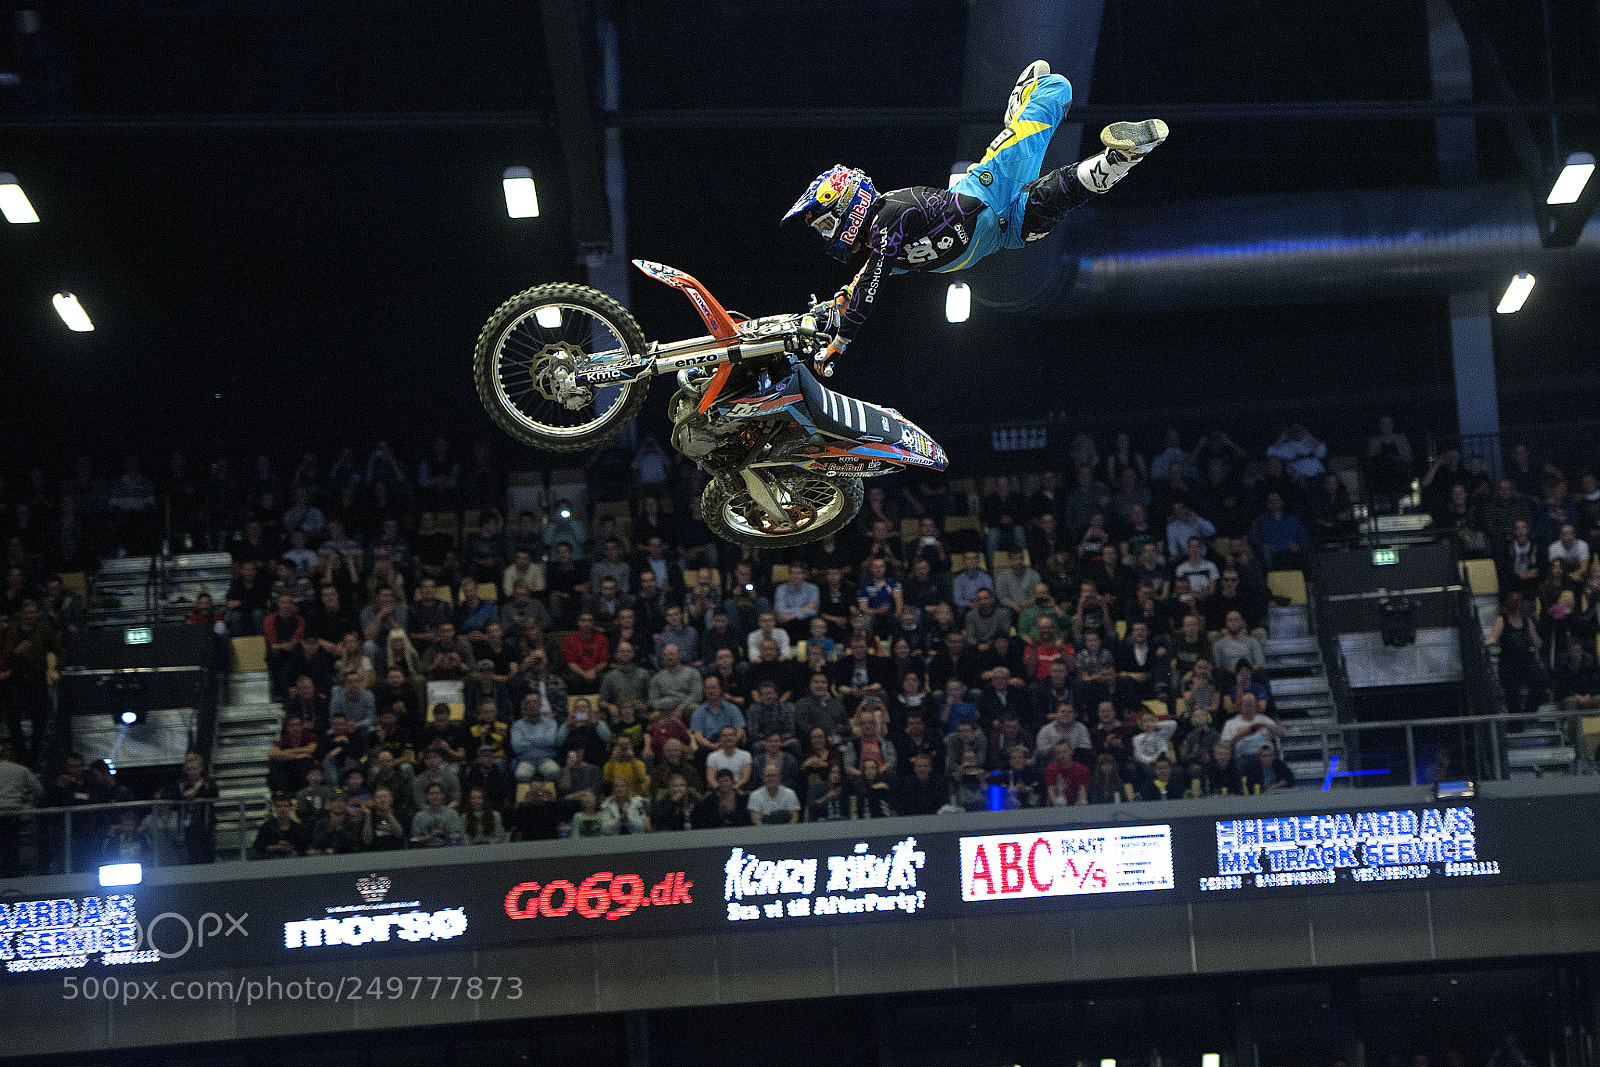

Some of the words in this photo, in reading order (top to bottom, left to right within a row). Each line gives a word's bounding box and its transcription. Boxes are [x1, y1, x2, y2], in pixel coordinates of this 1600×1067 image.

[674, 353, 718, 368] enzo
[970, 837, 1054, 896] ABC
[504, 871, 694, 921] GO69.dk
